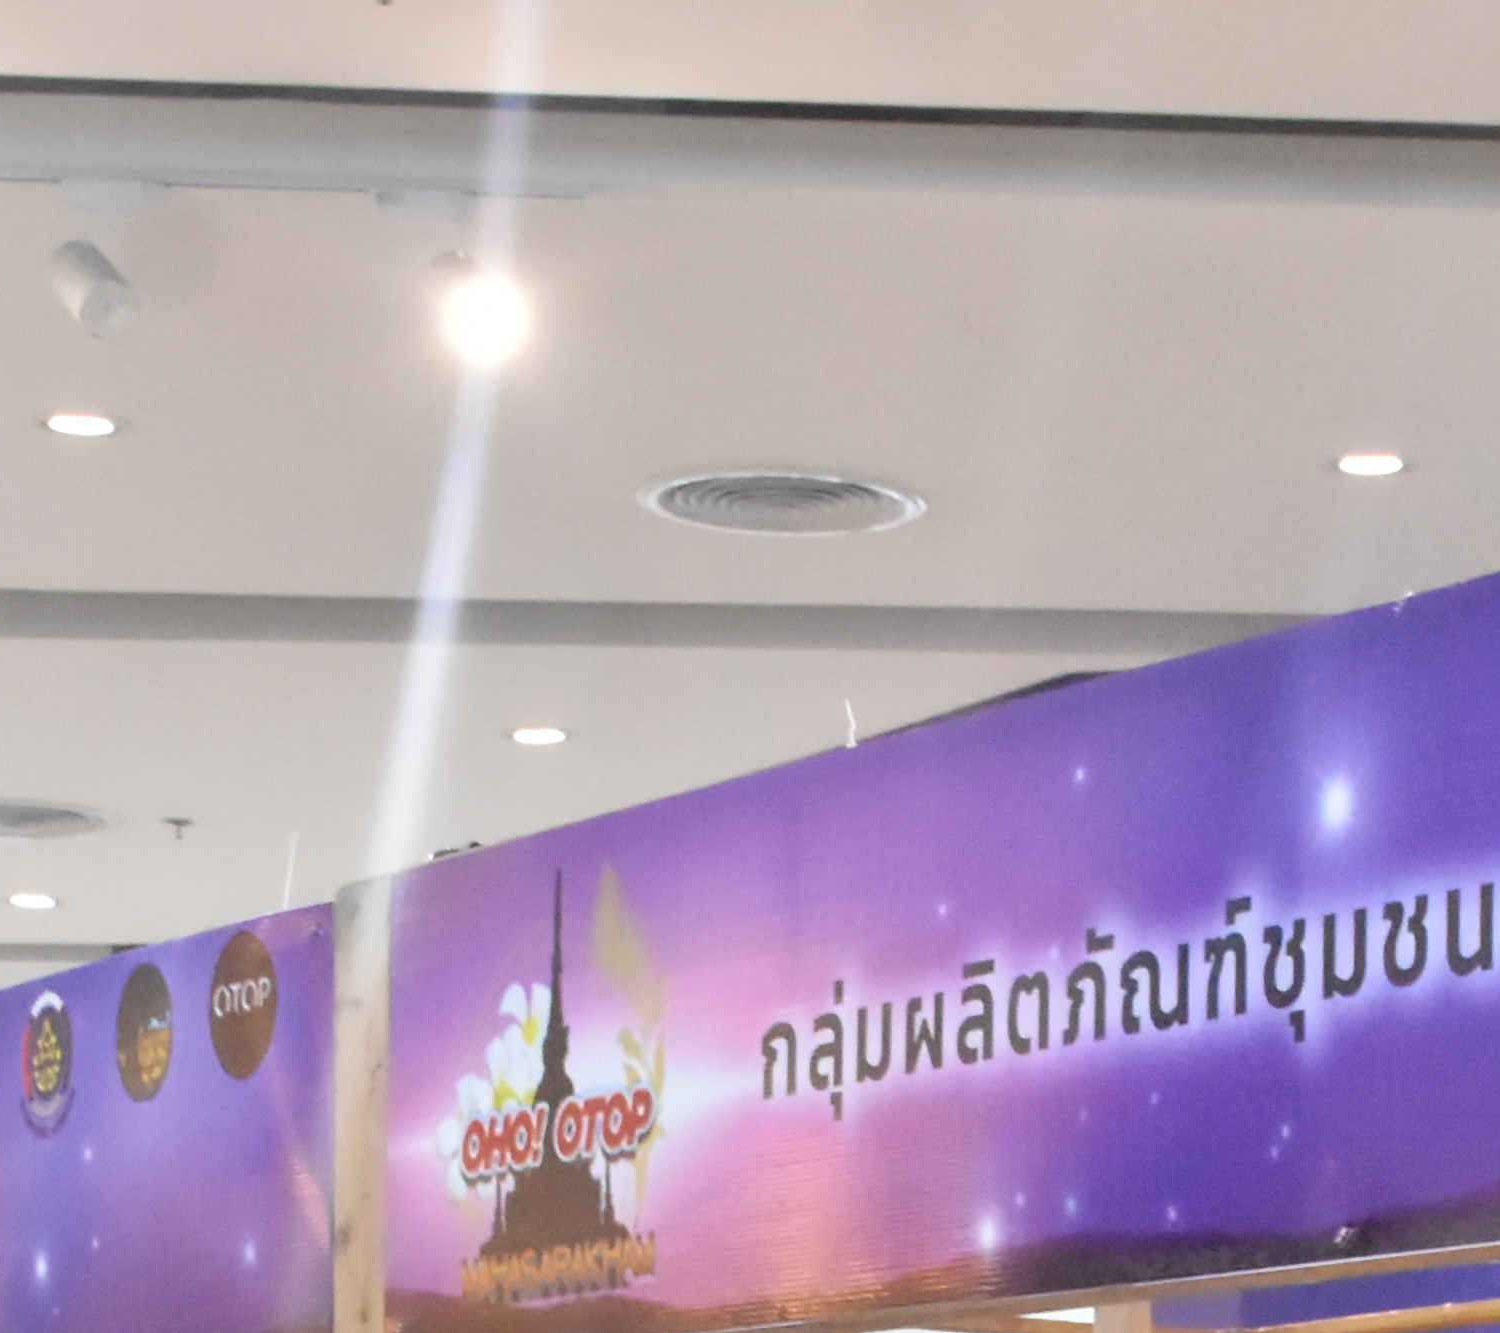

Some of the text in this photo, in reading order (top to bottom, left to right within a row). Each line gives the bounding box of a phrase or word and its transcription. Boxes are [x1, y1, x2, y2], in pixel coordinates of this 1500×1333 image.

[212, 976, 272, 1018] OTOP
[461, 1085, 655, 1175] OHO! OTOP
